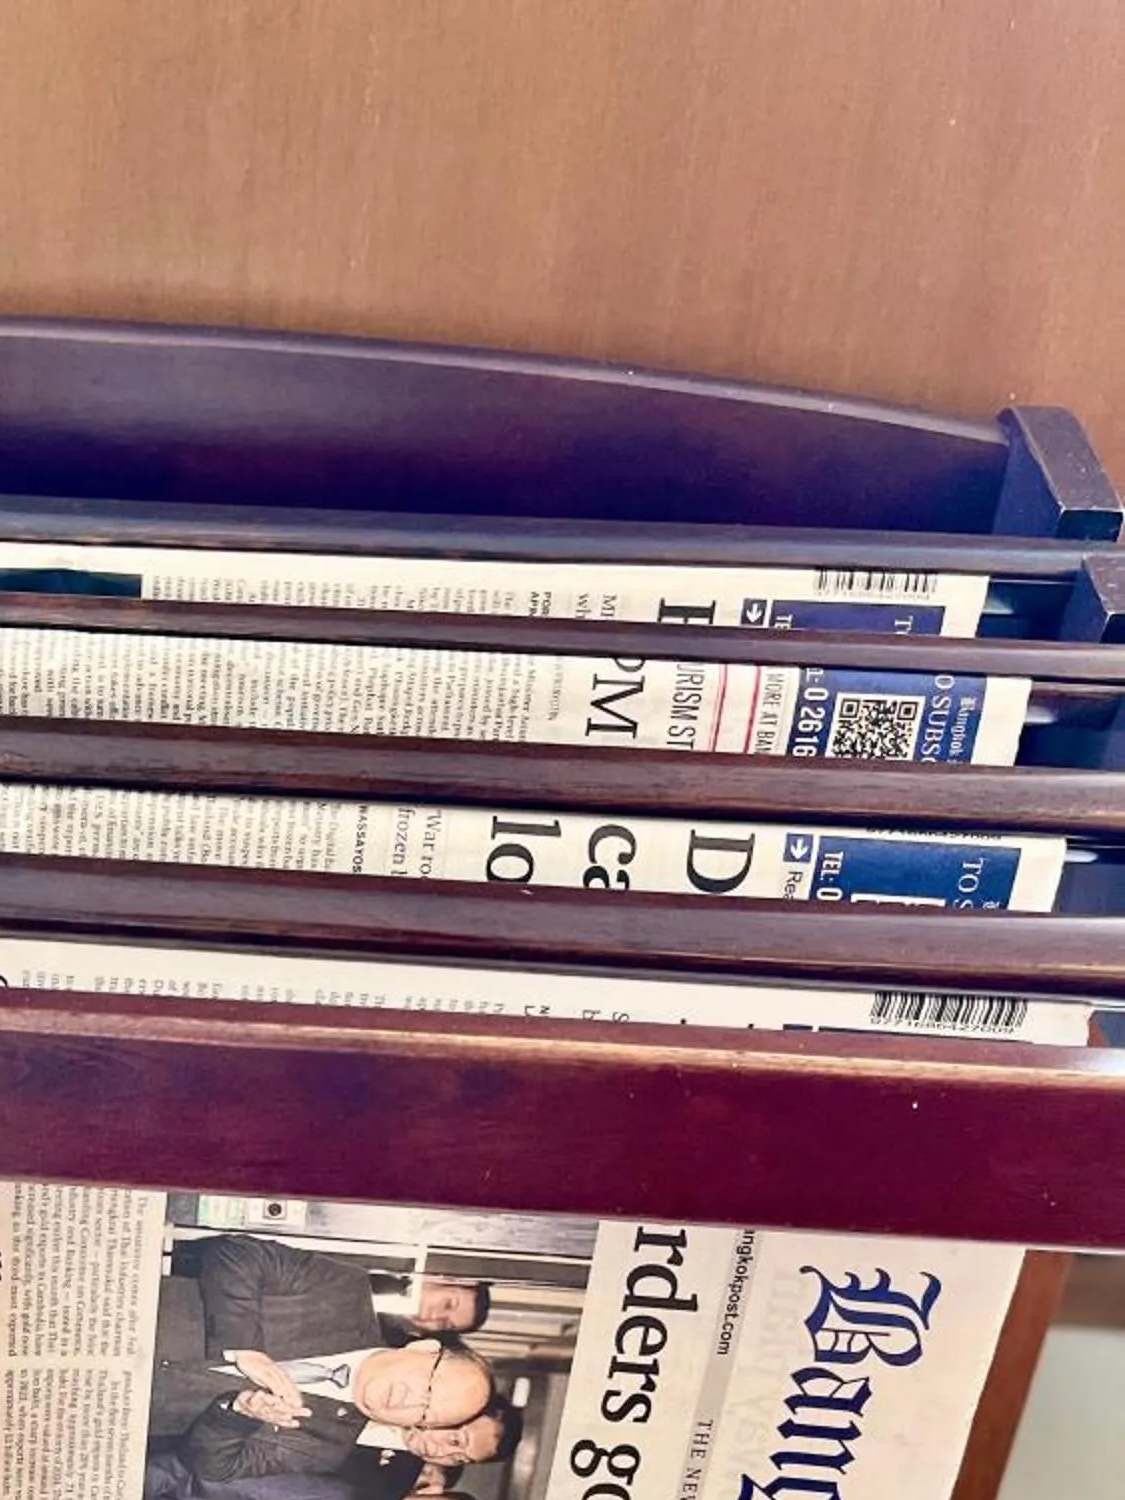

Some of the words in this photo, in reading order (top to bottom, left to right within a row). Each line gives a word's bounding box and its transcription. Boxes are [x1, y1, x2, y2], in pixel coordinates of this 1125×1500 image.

[762, 674, 785, 707] MORE
[804, 688, 829, 700] 0
[762, 712, 779, 726] AT
[793, 707, 825, 757] 2616
[950, 697, 977, 755] Bangkok
[392, 808, 416, 865] frozen
[419, 856, 432, 878] ro
[686, 829, 756, 894] D
[819, 852, 844, 881] TEL:
[958, 858, 985, 893] TO
[601, 1226, 698, 1424] rders
[690, 1419, 714, 1459] THE
